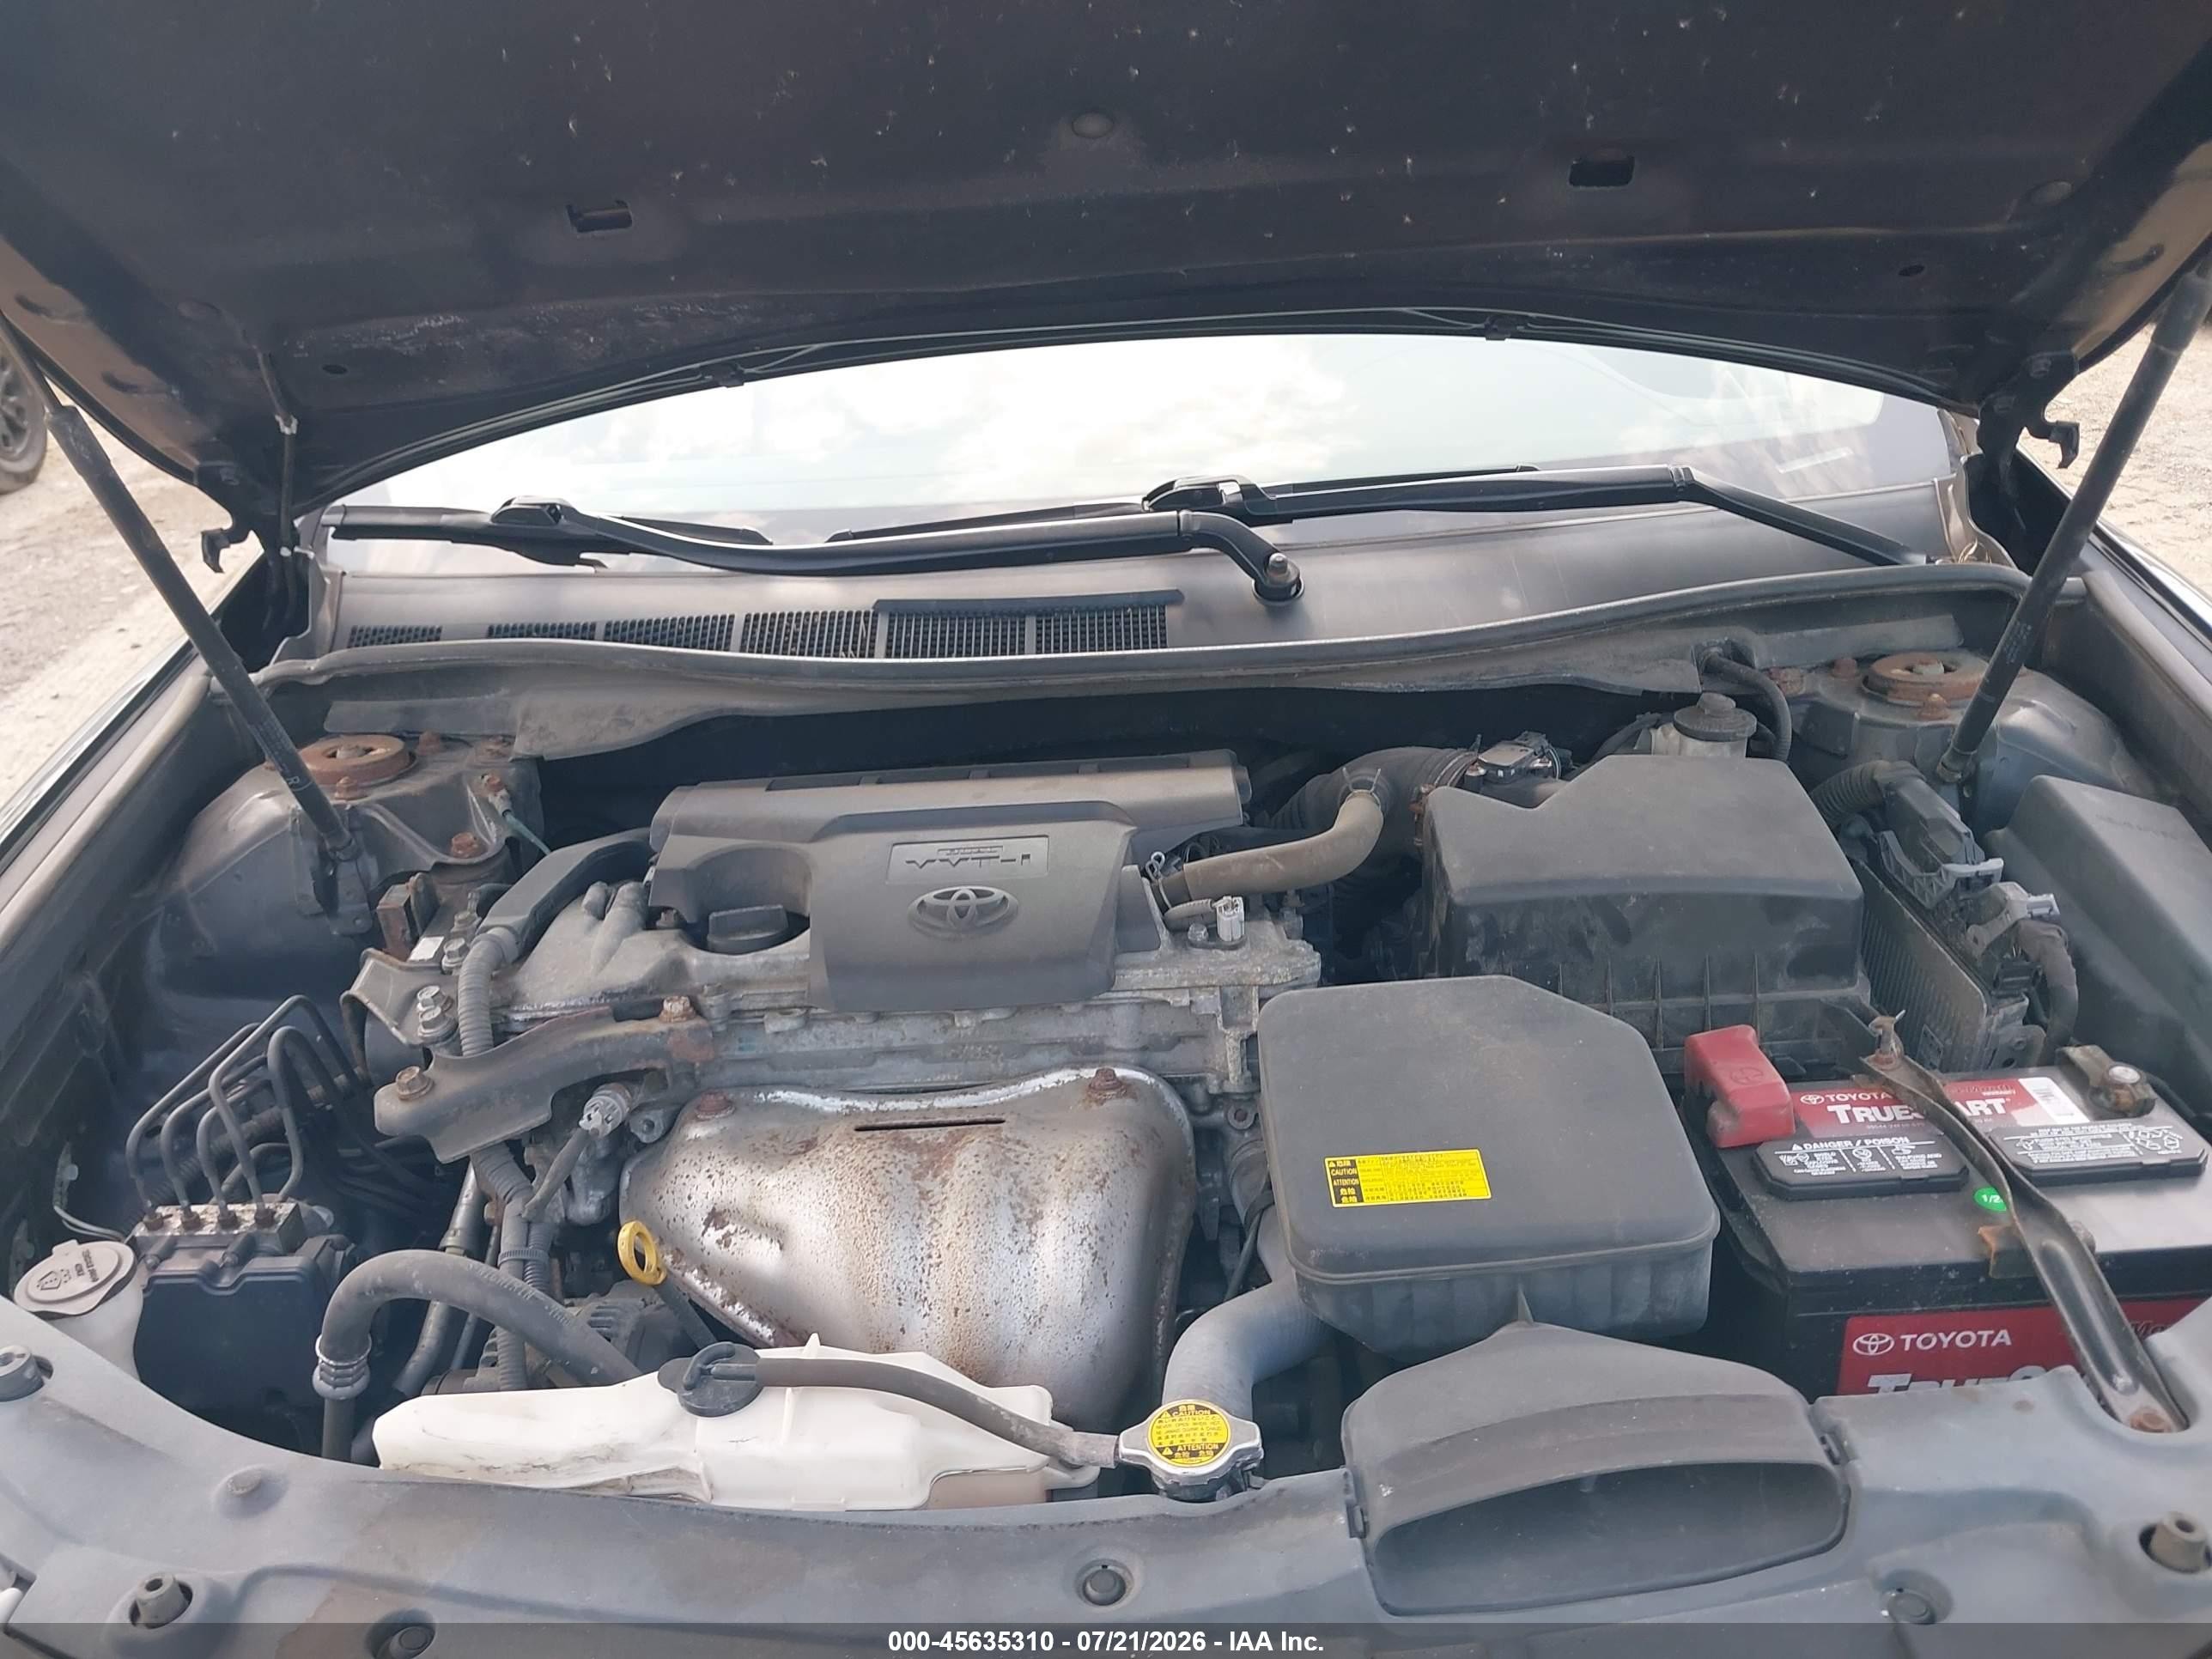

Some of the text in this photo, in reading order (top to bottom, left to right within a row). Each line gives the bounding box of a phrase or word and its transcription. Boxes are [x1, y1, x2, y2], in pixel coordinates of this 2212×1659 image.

[1825, 1091, 1894, 1103] TOYOTA
[1803, 1139, 1853, 1150] DANGER
[1865, 1137, 1910, 1146] POISON
[1981, 1194, 2003, 1203] 1/2
[1900, 1329, 2011, 1352] TOYOTA
